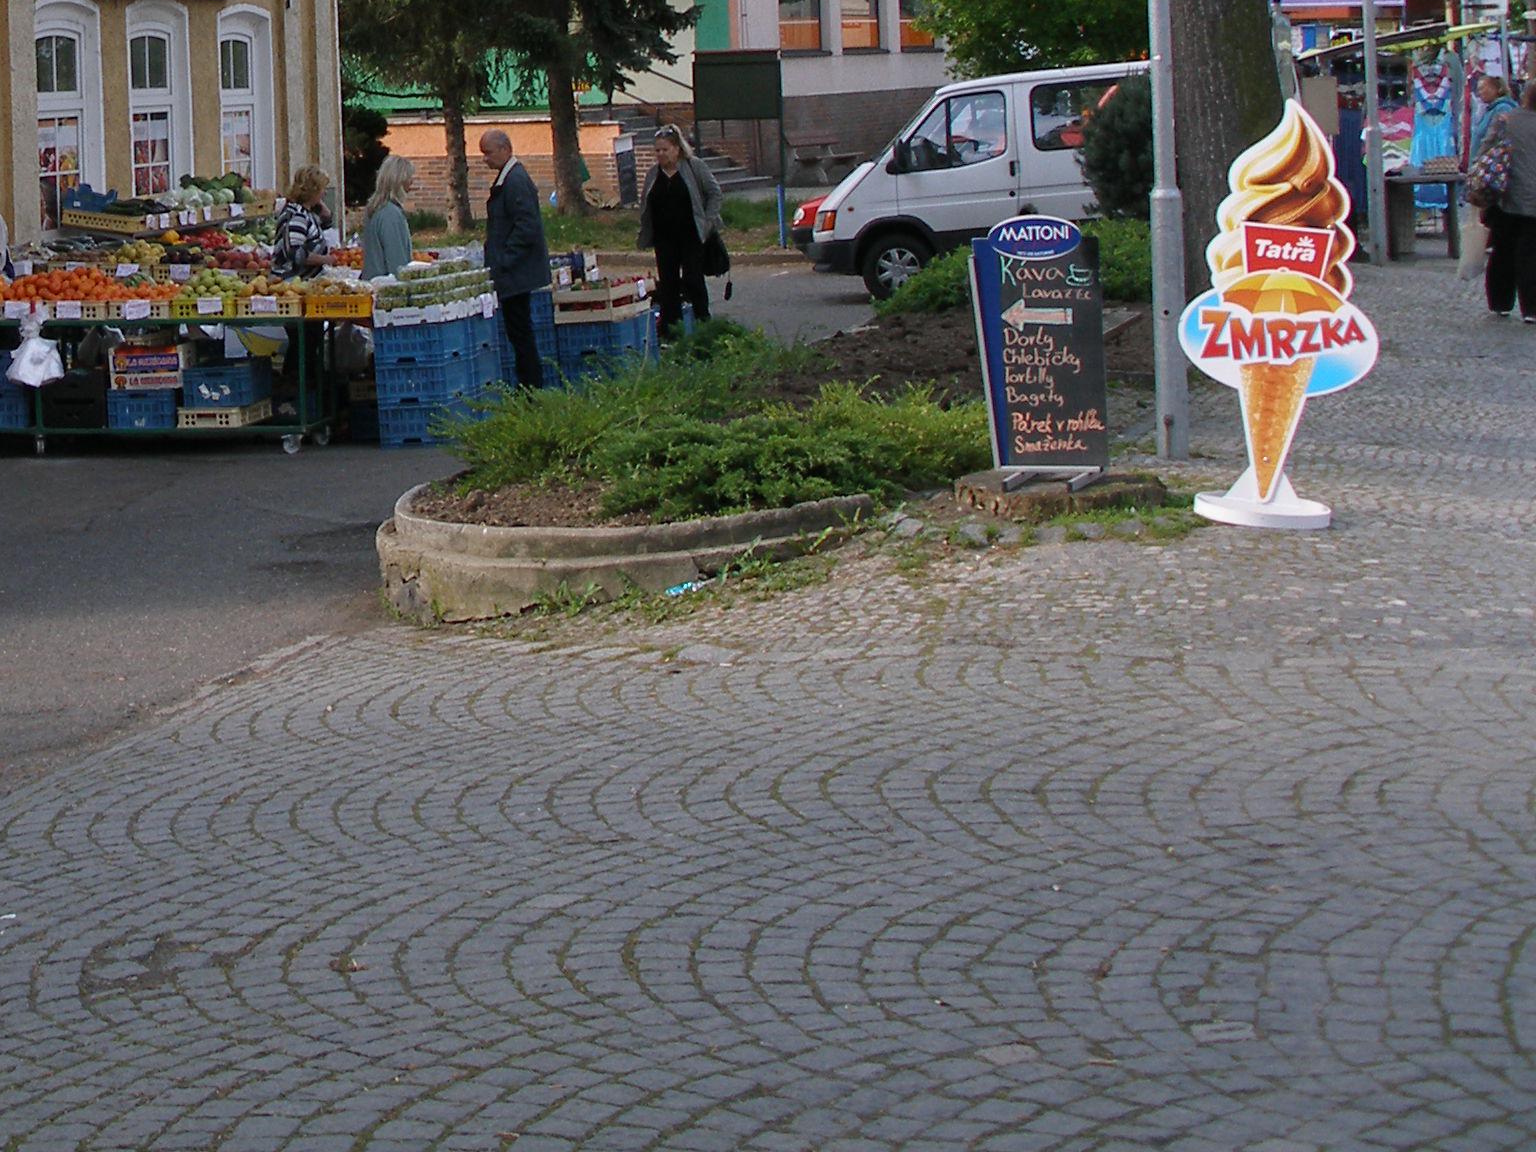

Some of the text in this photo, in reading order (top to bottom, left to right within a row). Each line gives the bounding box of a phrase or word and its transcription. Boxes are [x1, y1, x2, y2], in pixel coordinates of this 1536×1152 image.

[998, 224, 1070, 242] MATTONI
[1255, 239, 1317, 263] Tatra
[1000, 255, 1065, 287] Káva
[1004, 326, 1054, 351] Dorty
[1201, 309, 1367, 361] ZMRZKA
[1005, 386, 1064, 407] Bagety
